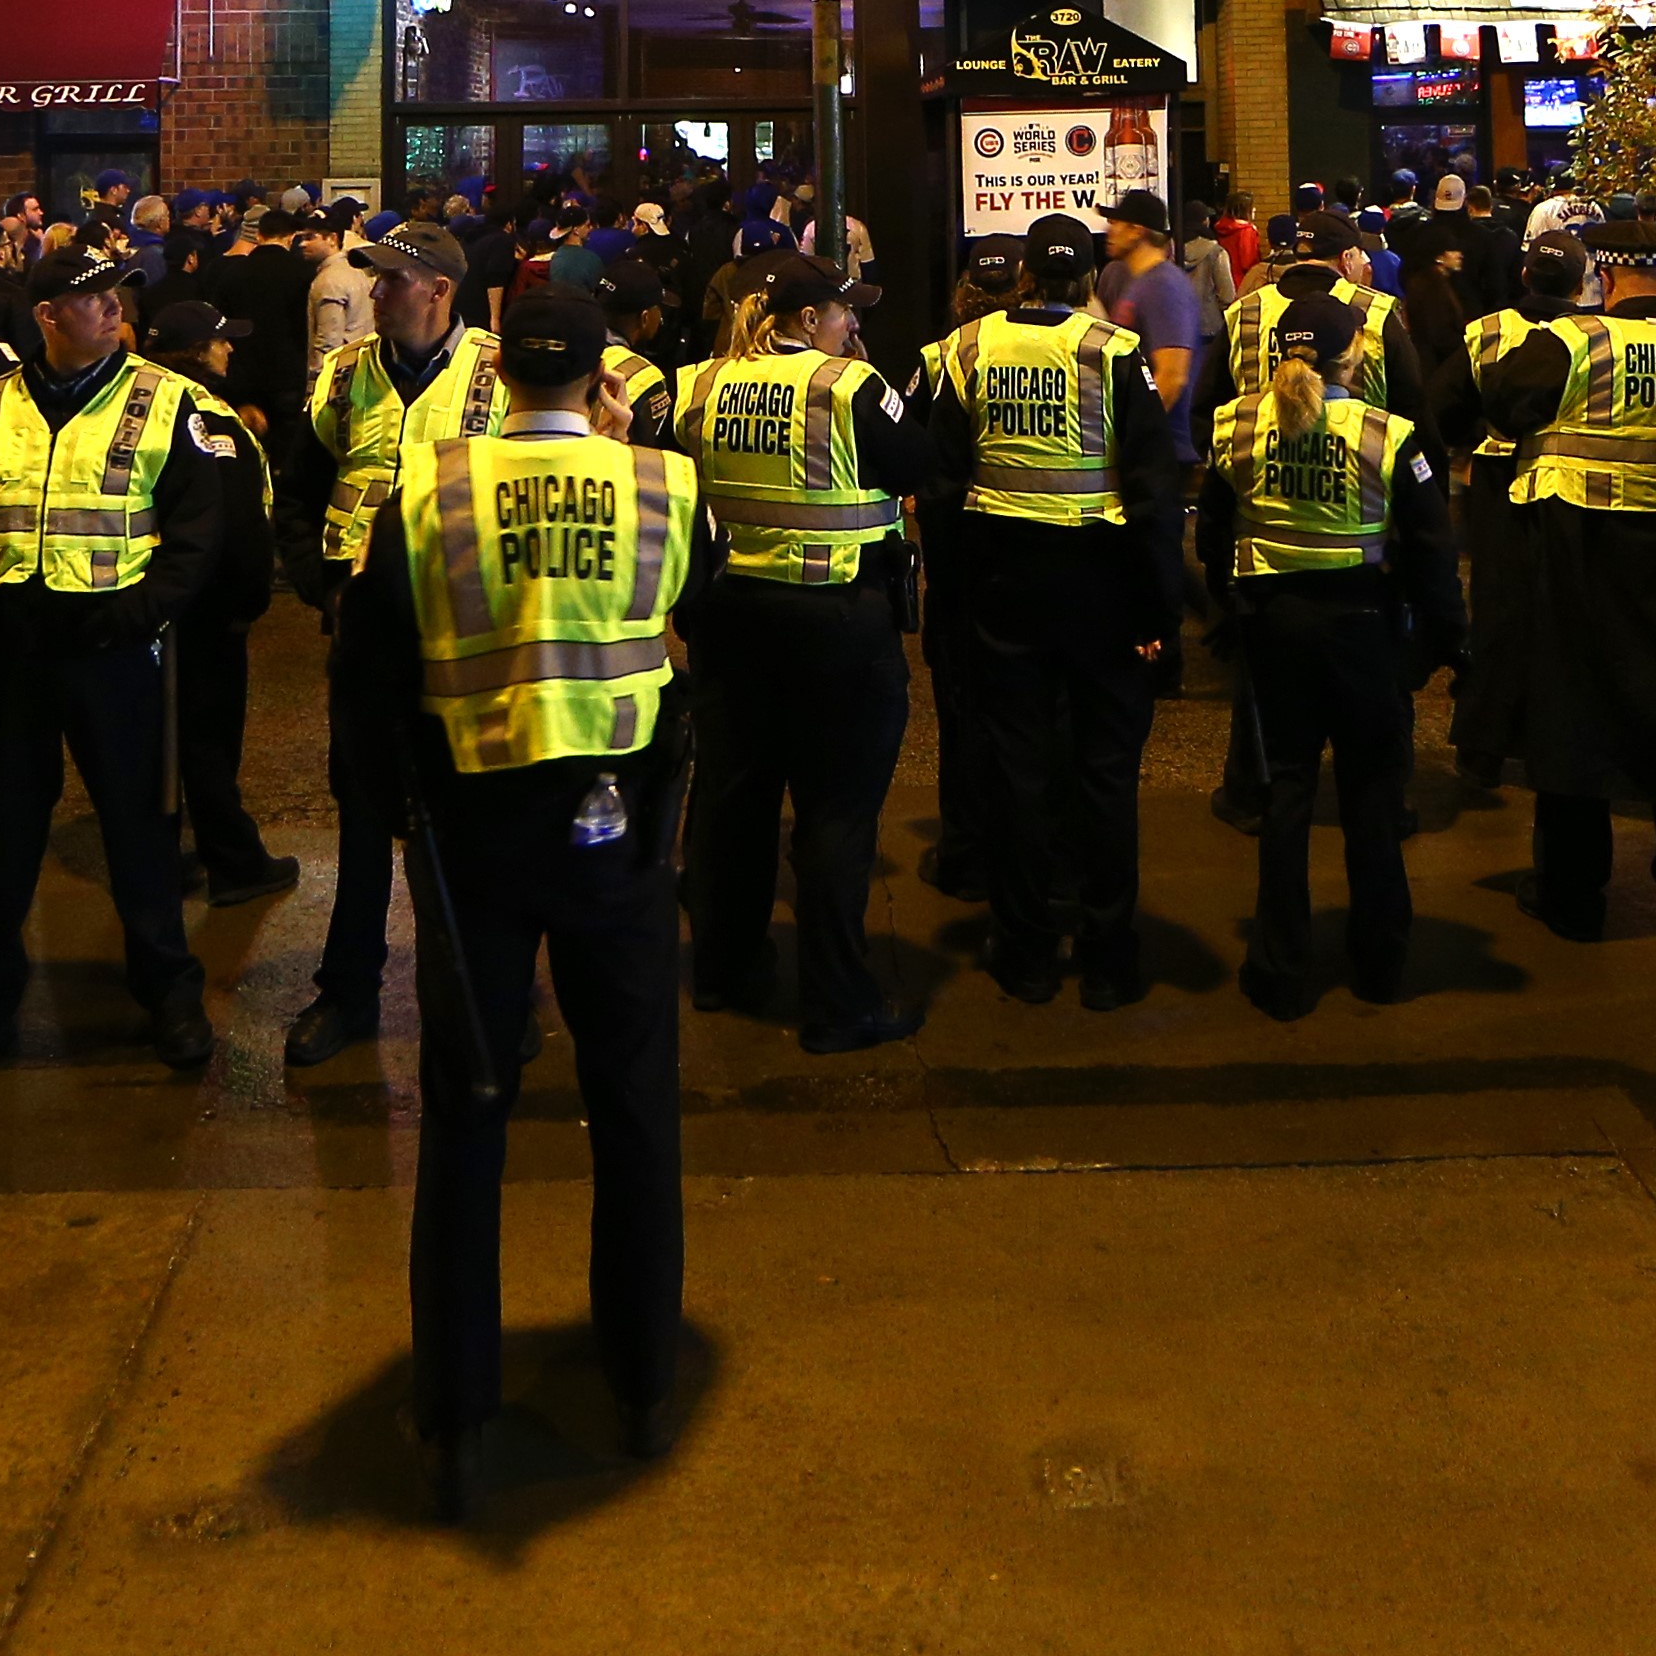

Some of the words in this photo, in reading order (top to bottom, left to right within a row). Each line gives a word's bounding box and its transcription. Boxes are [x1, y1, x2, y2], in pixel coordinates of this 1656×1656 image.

[1051, 12, 1080, 23] 3720
[956, 59, 1006, 70] LOUNGE
[1018, 37, 1107, 76] RAW
[1112, 57, 1160, 68] EATERY
[1051, 76, 1076, 86] BAR
[1080, 76, 1089, 85] &
[1093, 74, 1128, 85] GRILL
[31, 82, 146, 107] GRILL
[1013, 130, 1055, 141] WORLD
[1070, 128, 1089, 154] C
[1014, 141, 1056, 154] SERIES
[975, 173, 1006, 187] THIS
[1011, 175, 1022, 187] IS
[1027, 174, 1055, 186] OUR
[1060, 171, 1099, 185] YEAR!
[975, 192, 1014, 211] FLY
[1021, 191, 1065, 210] THE
[979, 256, 1005, 266] CPD
[1048, 245, 1074, 255] CPD
[1539, 245, 1564, 257] CPD
[599, 277, 616, 292] PD
[1285, 332, 1314, 342] CPD
[987, 366, 1066, 402] CHICAGO
[463, 360, 494, 437] POLIC
[717, 382, 794, 418] CHICAGO
[111, 387, 152, 470] POLICE
[987, 402, 1067, 437] POLICE
[714, 417, 793, 456] POLICE
[1266, 429, 1346, 468] CHICAGO
[1266, 464, 1346, 504] POLICE
[497, 474, 616, 529] CHICAGO
[499, 526, 616, 584] POLICE
